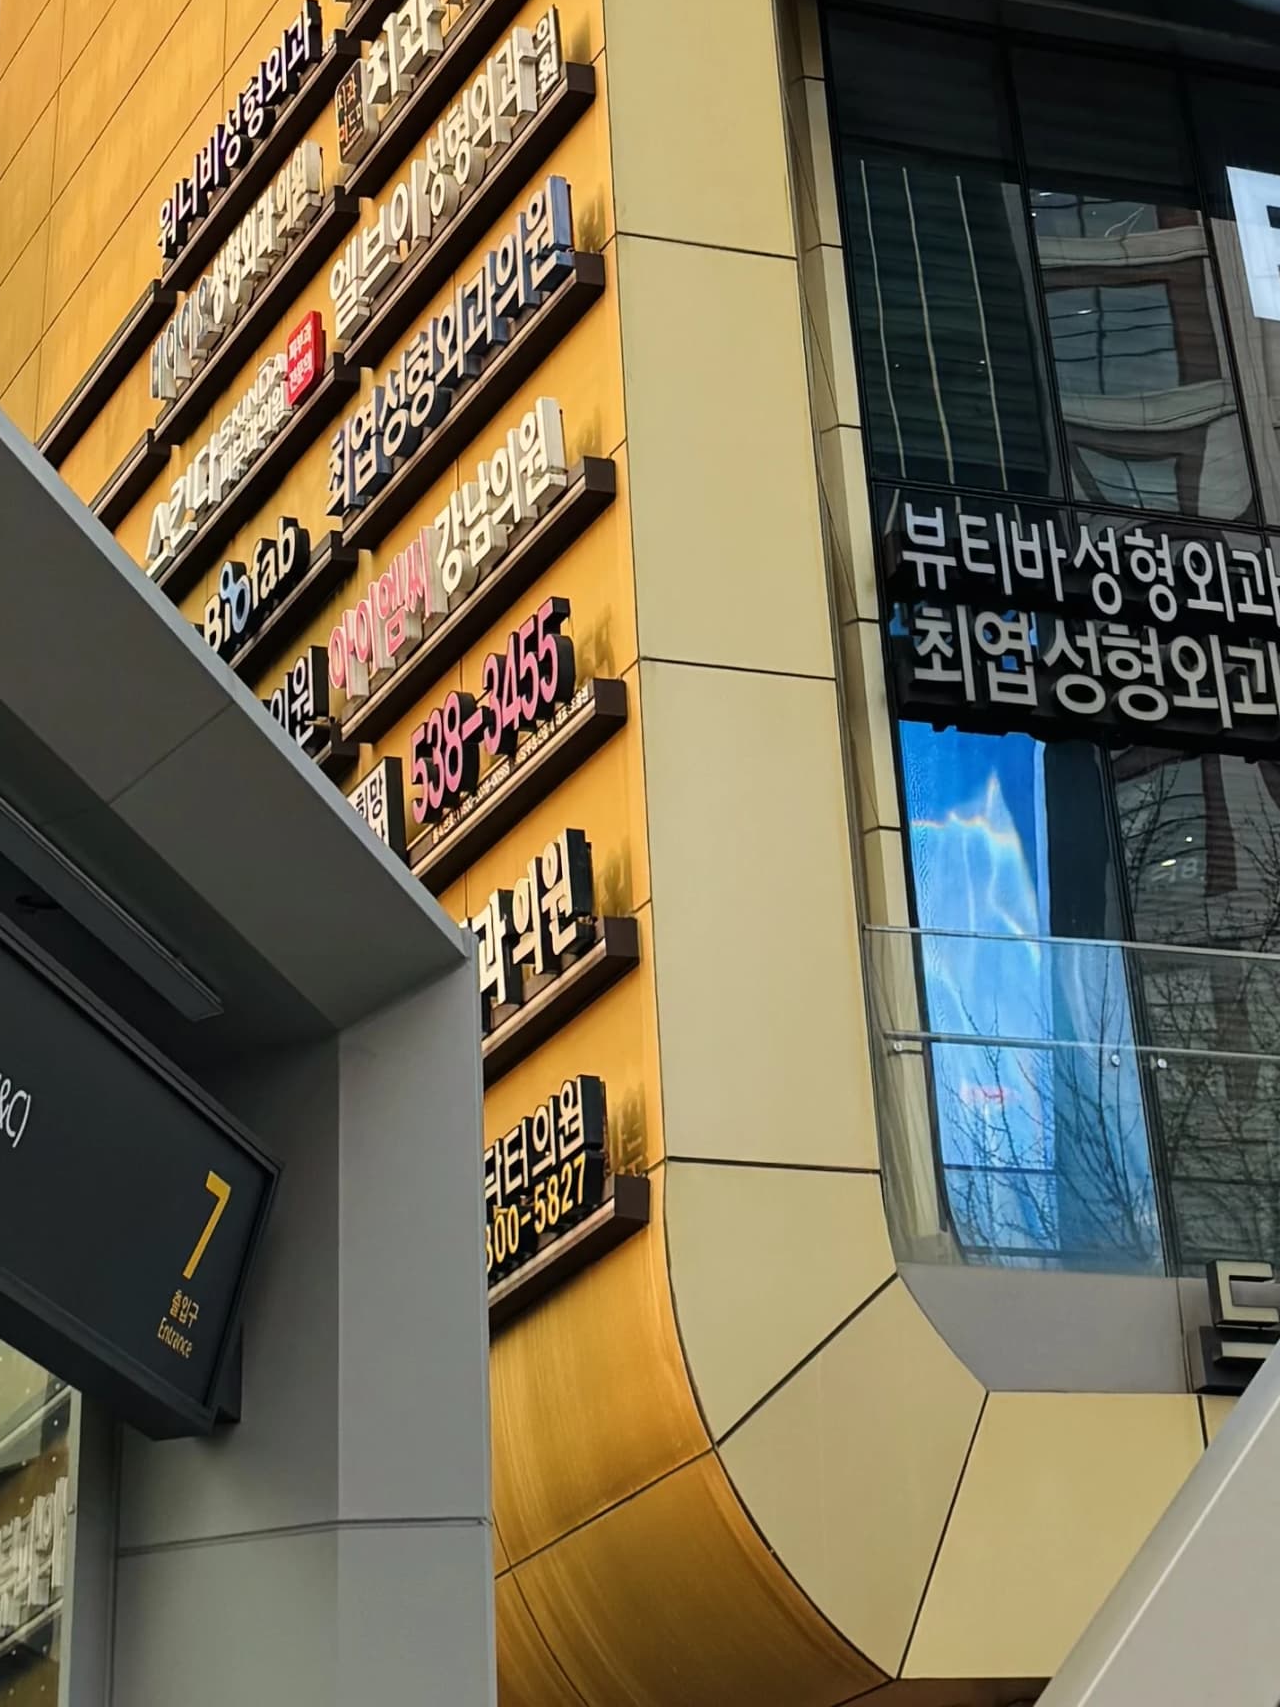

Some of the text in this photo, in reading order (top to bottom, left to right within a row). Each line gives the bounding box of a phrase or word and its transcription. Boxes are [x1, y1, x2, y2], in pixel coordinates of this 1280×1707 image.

[326, 176, 570, 516] 최엽성형외과의원
[410, 597, 570, 826] 538-3455
[459, 829, 577, 1005] 과의원
[182, 1170, 232, 1280] 7
[157, 1316, 193, 1359] Entrance
[169, 1289, 200, 1329] 출입구
